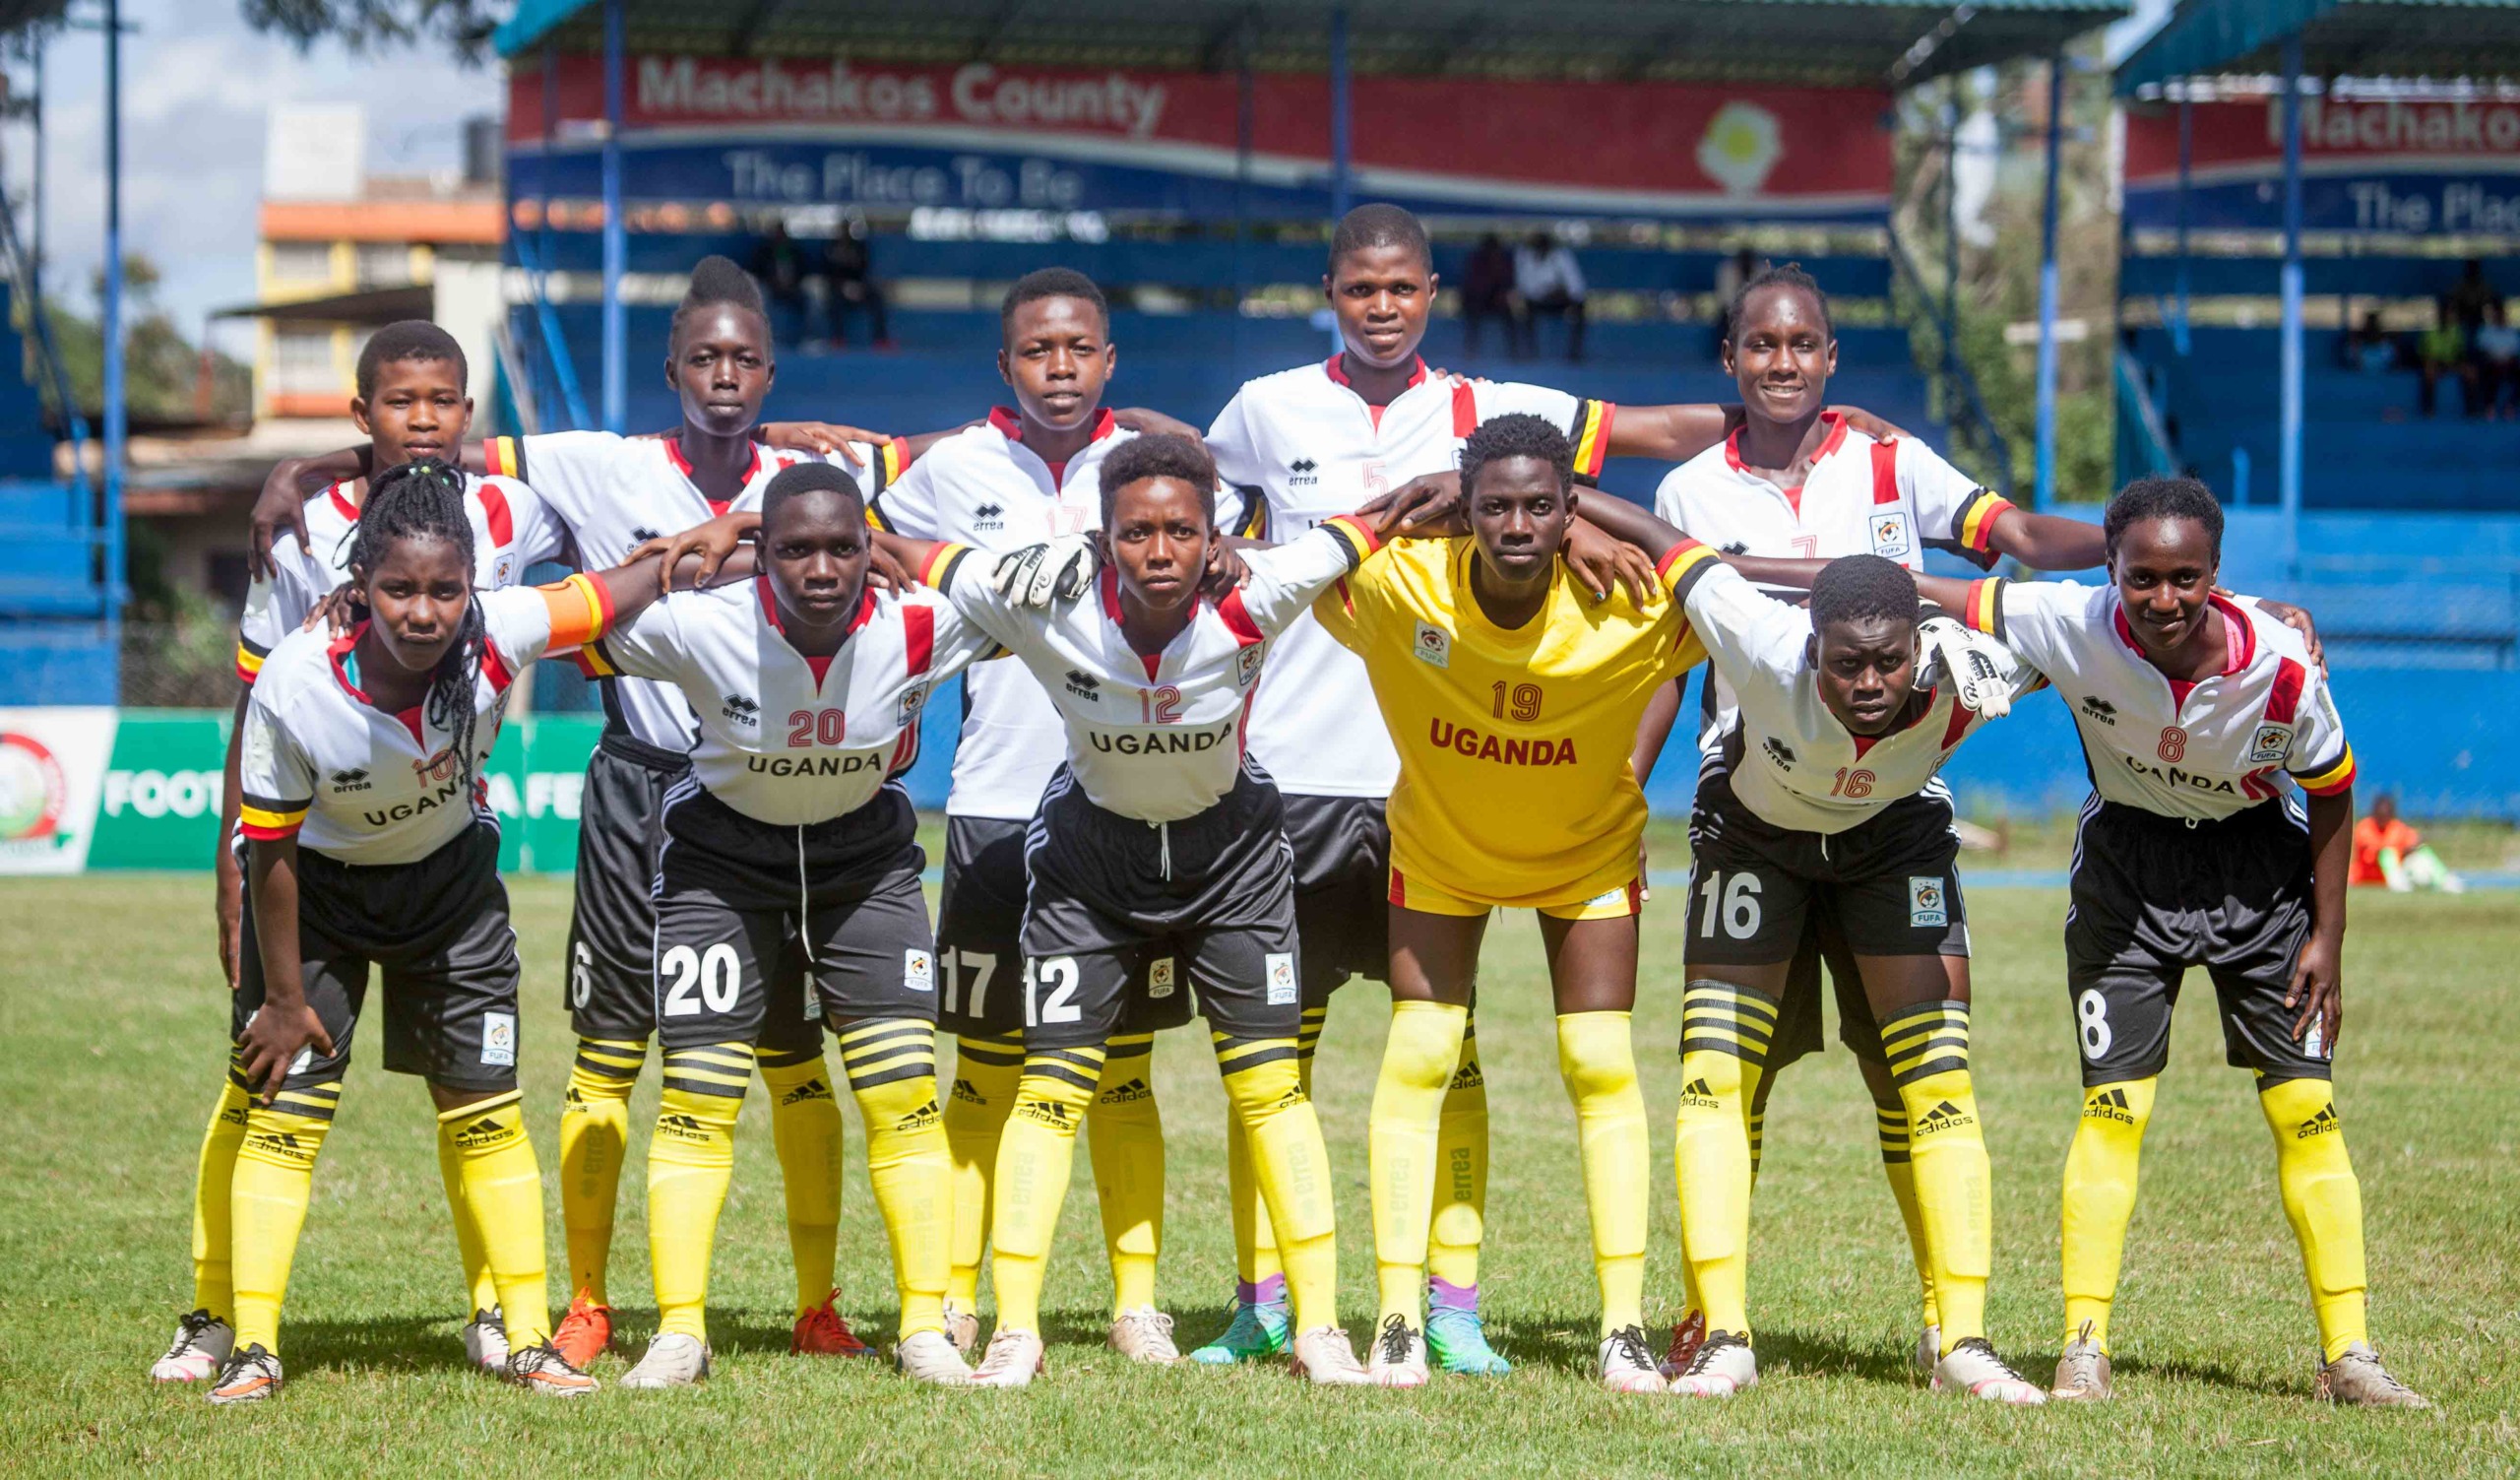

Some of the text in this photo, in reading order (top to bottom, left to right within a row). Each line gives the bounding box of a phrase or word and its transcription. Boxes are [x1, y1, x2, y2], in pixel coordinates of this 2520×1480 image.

[637, 58, 1167, 139] Machakos County
[723, 150, 1084, 205] The Place To Be
[2347, 180, 2431, 232] The
[1289, 477, 1318, 486] errea
[973, 519, 1005, 532] errea
[1045, 505, 1089, 539] 17
[1065, 681, 1100, 703] errea
[1137, 685, 1182, 725] 12
[1491, 679, 1544, 722] 19
[721, 705, 758, 728] errea
[788, 708, 846, 748] 20
[2081, 705, 2115, 727] errea
[1089, 721, 1232, 755] UGANDA
[1429, 716, 1578, 766] UGANDA
[2157, 726, 2187, 763] 8
[410, 748, 456, 789] 10
[747, 752, 882, 777] UGANDA
[1762, 741, 1792, 773] errea
[333, 781, 372, 794] errea
[1830, 766, 1876, 799] 16
[1700, 870, 1763, 940] 16
[1918, 914, 1941, 923] FUFA
[572, 940, 593, 1009] 6
[661, 942, 741, 1017] 20
[940, 944, 997, 1019] 17
[1022, 955, 1082, 1027] 12
[2078, 989, 2112, 1060] 8
[782, 1090, 833, 1107] adidas
[1100, 1087, 1153, 1106] adidas
[1018, 1108, 1070, 1130] adidas
[1916, 1115, 1974, 1137] adidas
[2083, 1105, 2135, 1126] adidas
[246, 1138, 305, 1160] adidas
[455, 1128, 515, 1148] adidas
[1390, 1156, 1411, 1212] errea
[1450, 1146, 1473, 1202] errea
